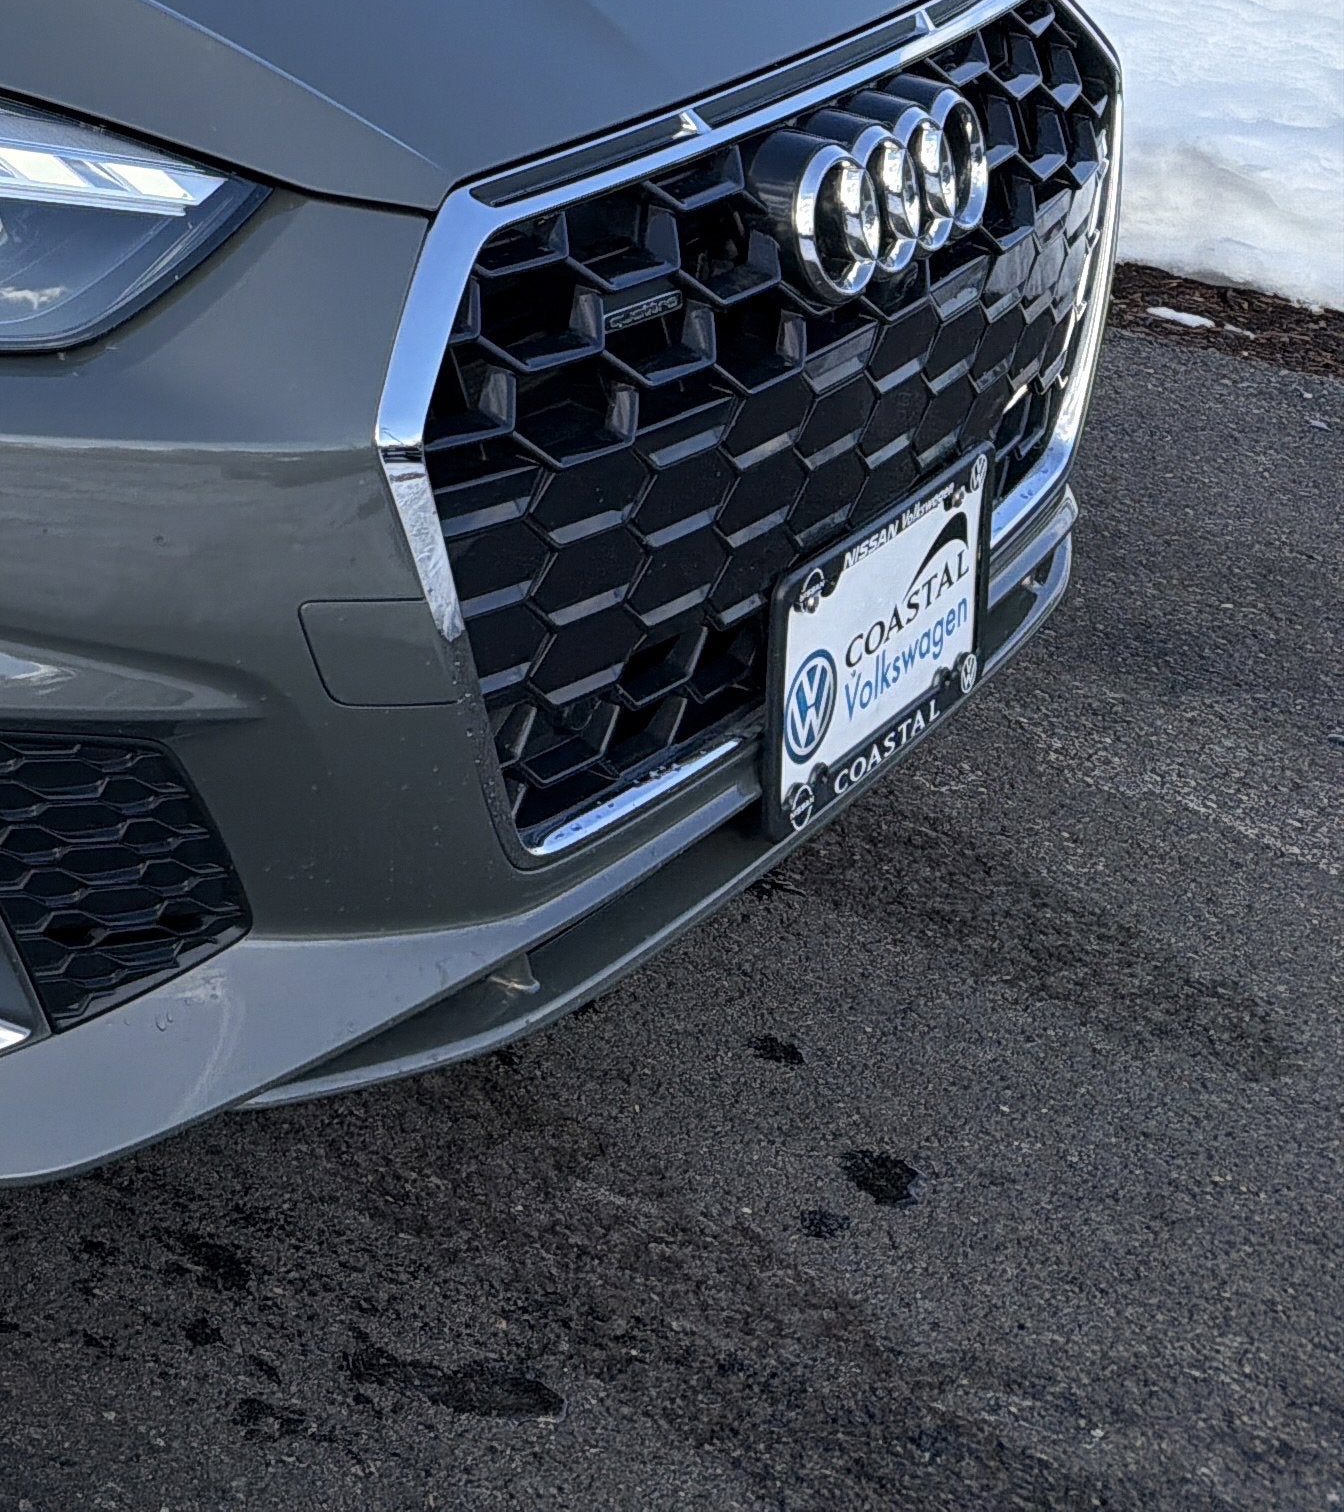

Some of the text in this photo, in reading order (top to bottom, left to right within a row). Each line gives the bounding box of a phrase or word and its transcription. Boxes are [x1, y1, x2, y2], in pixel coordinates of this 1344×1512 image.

[609, 295, 678, 329] quattro
[843, 519, 899, 569] NISSAN
[845, 549, 970, 668] COASTAL
[844, 597, 968, 722] Volkswagen
[834, 699, 940, 794] COASTAL
